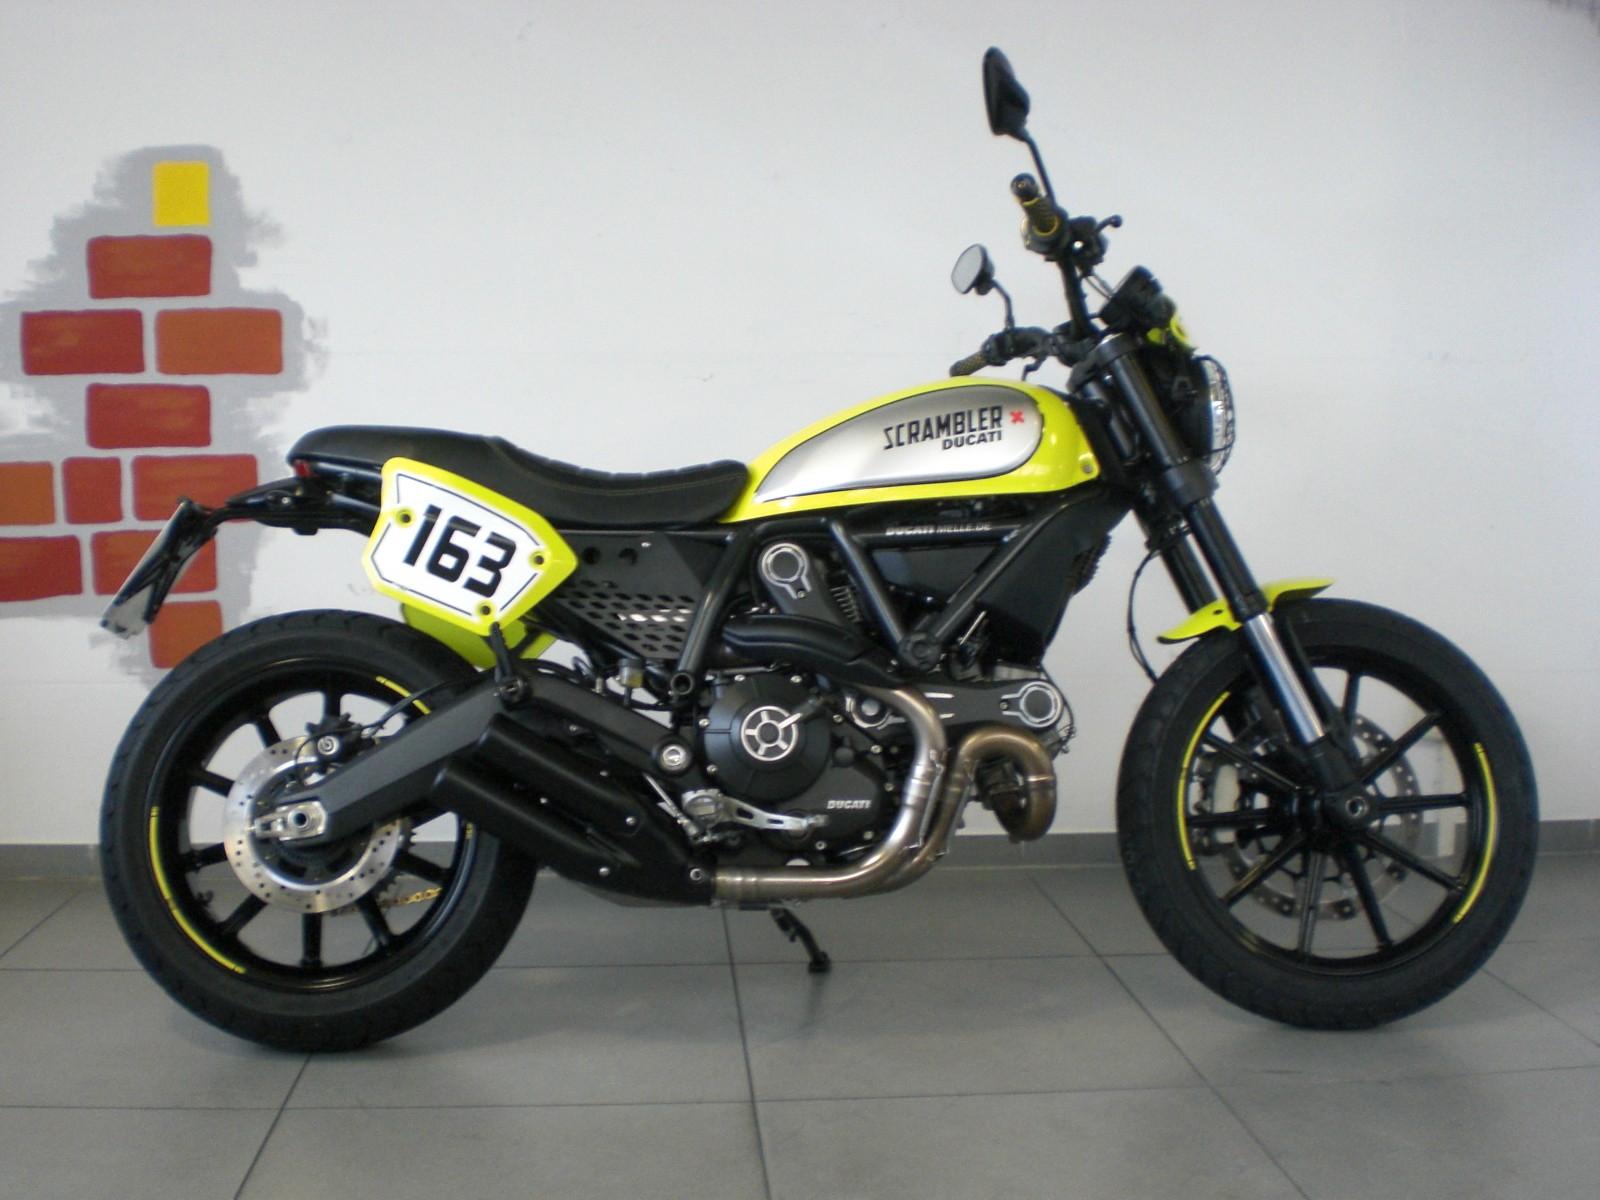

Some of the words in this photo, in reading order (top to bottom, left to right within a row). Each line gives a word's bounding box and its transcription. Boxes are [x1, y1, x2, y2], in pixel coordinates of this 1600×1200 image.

[883, 406, 1003, 450] SCRAMBLER
[942, 430, 1002, 450] DUCATI
[403, 504, 516, 598] 163
[827, 800, 871, 809] DUCATI
